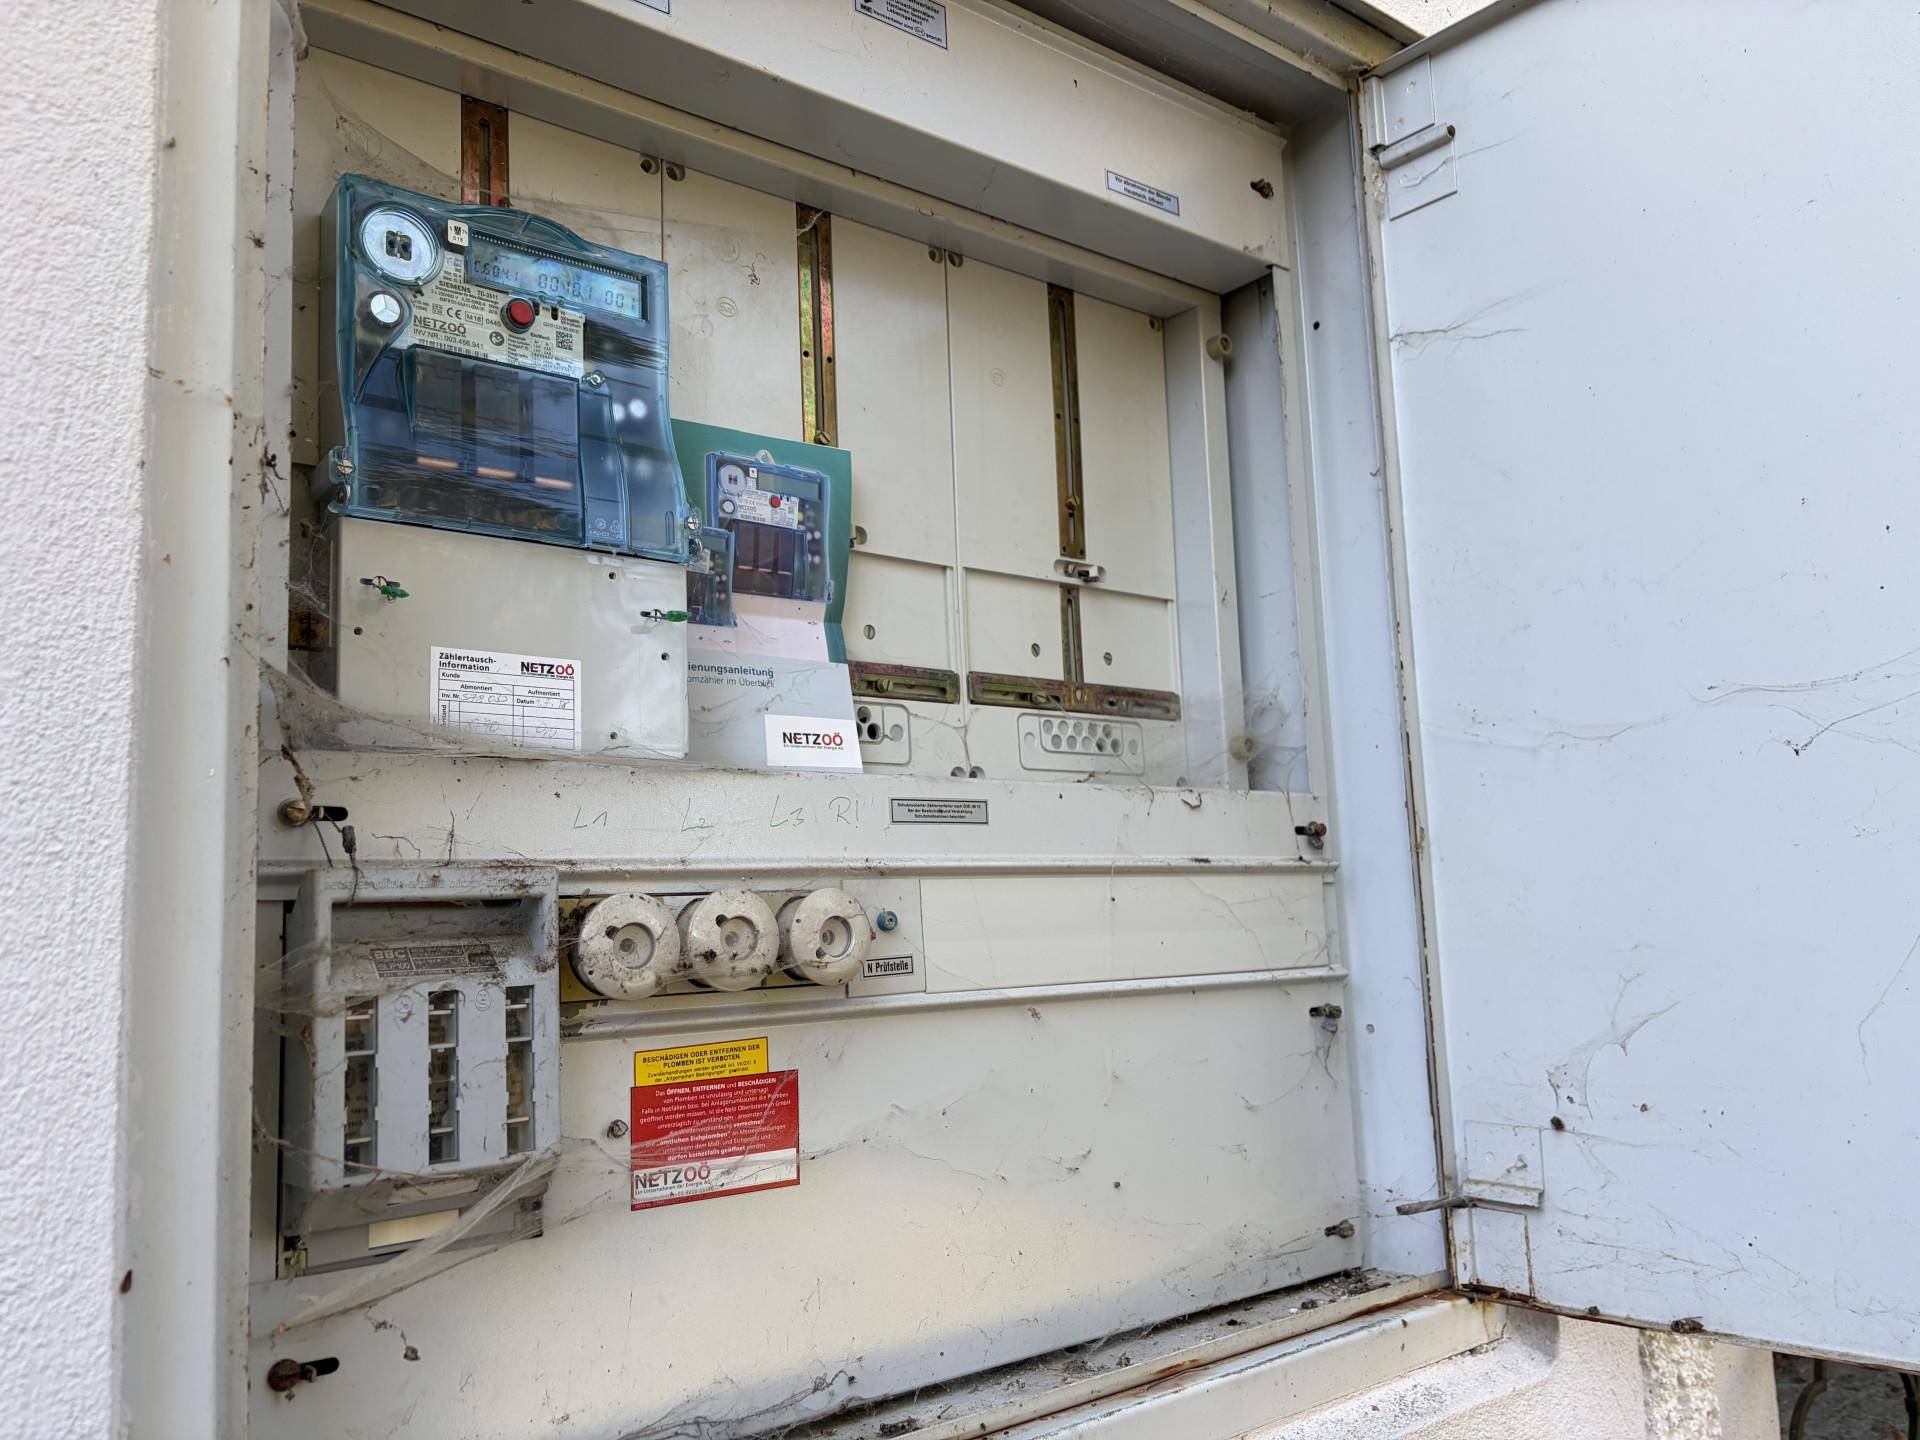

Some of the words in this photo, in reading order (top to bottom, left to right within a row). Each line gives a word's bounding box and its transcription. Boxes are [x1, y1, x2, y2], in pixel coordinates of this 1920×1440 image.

[439, 280, 471, 294] SIEMENS
[413, 314, 467, 335] NETZOÖ
[439, 652, 497, 664] Zählertausch-
[439, 660, 490, 672] Information
[521, 661, 575, 676] NETZOÖ
[687, 662, 774, 678] ienungsanleitung
[687, 675, 724, 685] omzähler
[726, 677, 736, 685] im
[739, 676, 775, 688] Überblick
[460, 684, 493, 692] Abmontiert
[527, 689, 561, 697] Aufmontiert
[782, 731, 844, 746] NETZOÖ
[573, 805, 608, 829] L1
[681, 797, 714, 832] L2
[770, 795, 805, 827] L3
[868, 963, 873, 973] N
[876, 960, 909, 973] Prüfstelle
[642, 1051, 688, 1063] BESCHÄDIGEN
[690, 1049, 707, 1057] ODER
[709, 1045, 746, 1055] ENTFERNEN
[747, 1043, 760, 1051] DER
[663, 1058, 693, 1068] PLOMBEN
[692, 1082, 725, 1092] ENTFERNEN
[737, 1077, 776, 1087] BESCHÄDIGEN
[674, 1094, 697, 1103] Plomben
[664, 1112, 685, 1121] werden
[667, 1152, 687, 1162] dürfen
[688, 1147, 719, 1159] keinesfalls
[720, 1144, 745, 1154] geöffnet
[635, 1161, 711, 1190] NETZOÖ
